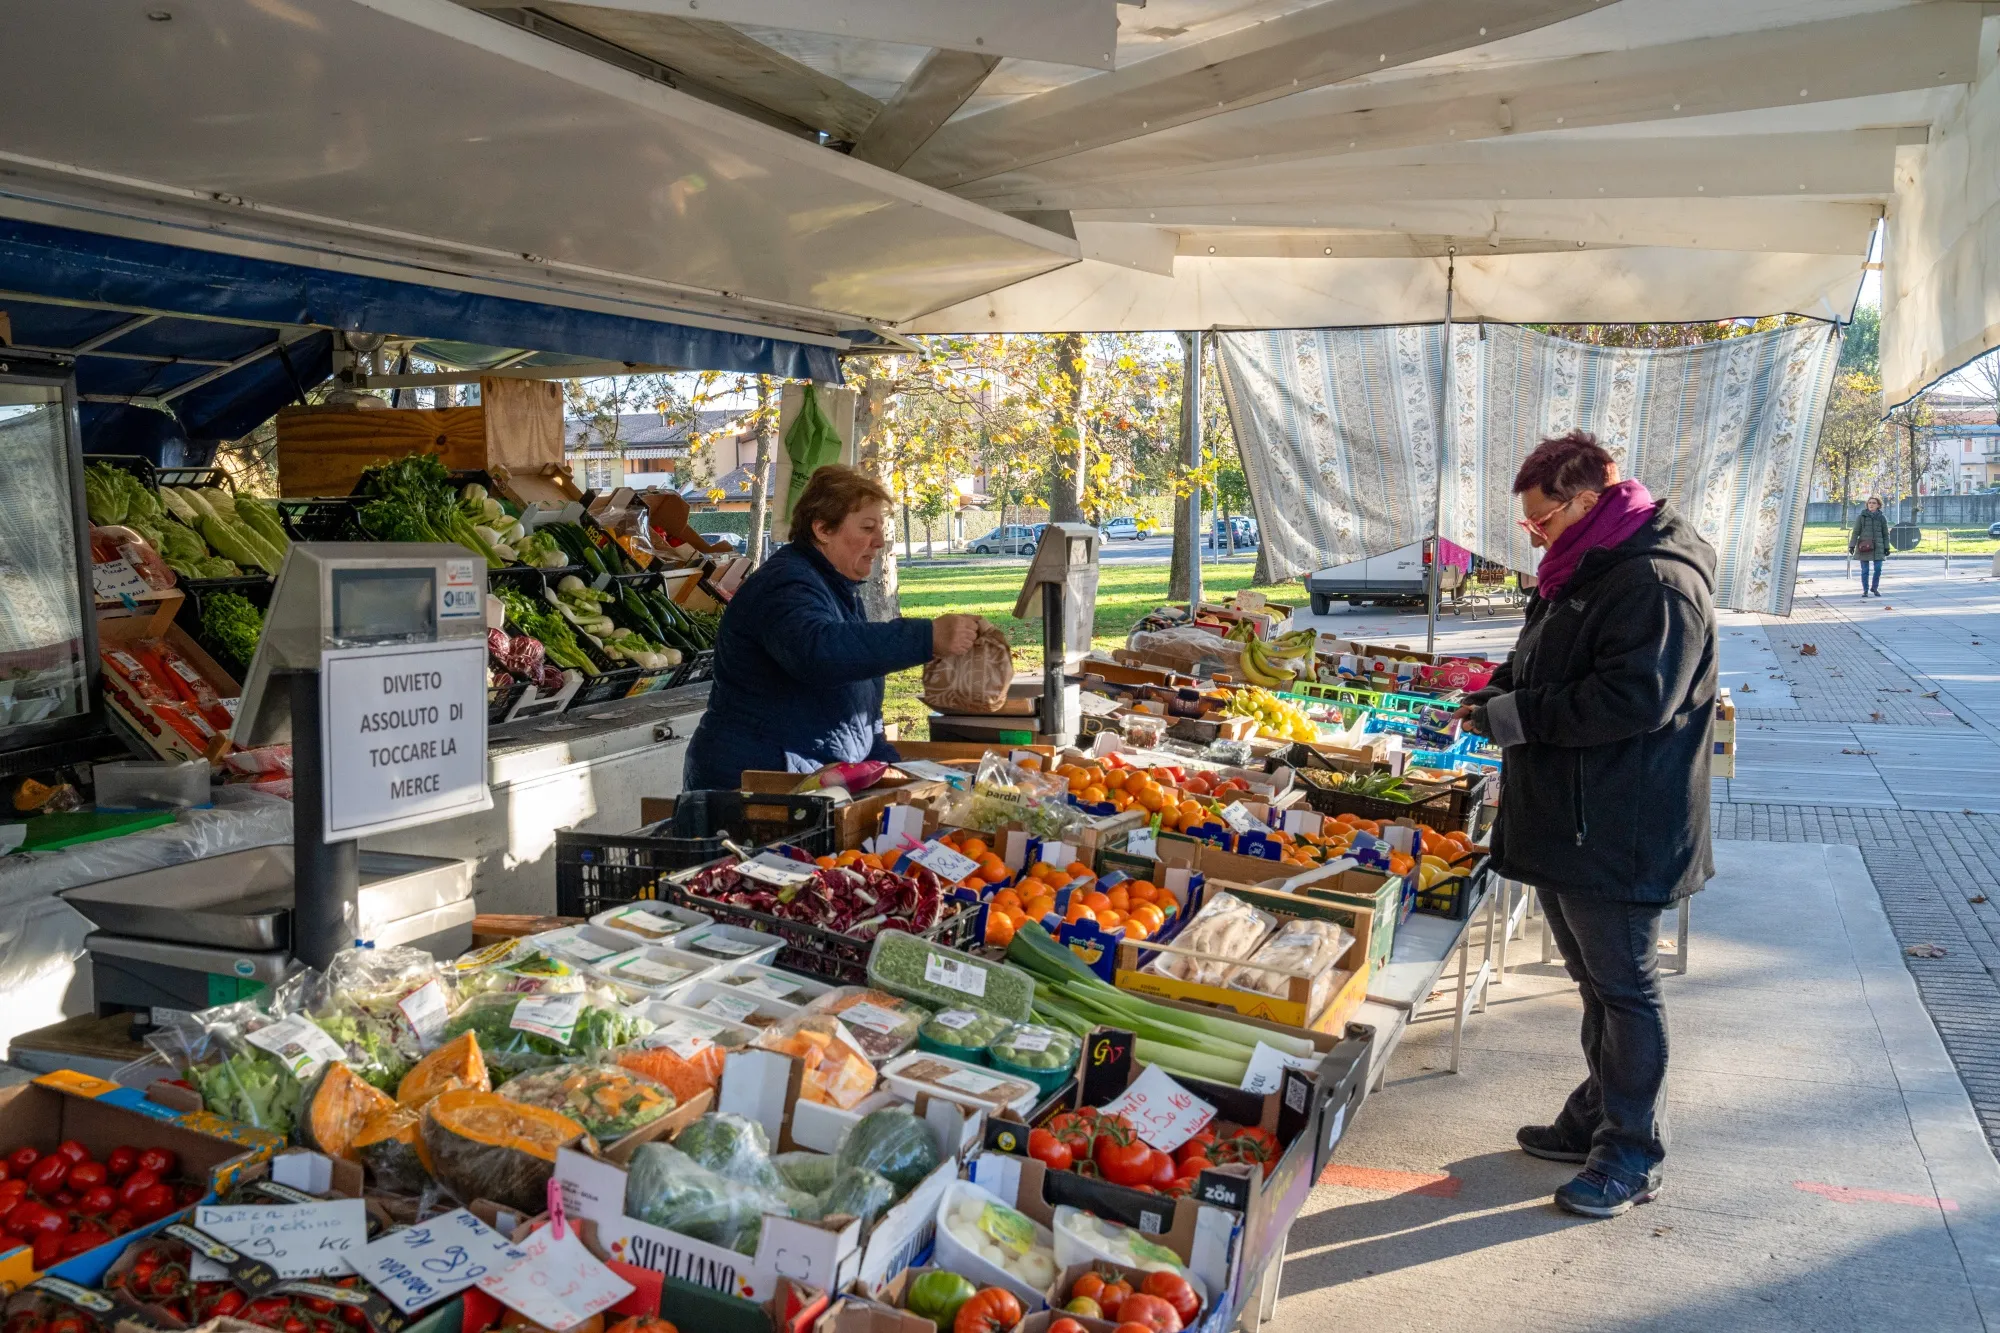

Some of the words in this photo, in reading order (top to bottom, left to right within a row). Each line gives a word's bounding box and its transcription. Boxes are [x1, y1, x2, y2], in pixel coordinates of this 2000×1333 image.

[383, 671, 442, 695] DIVIETO
[360, 706, 439, 734] ASSOLUTO
[450, 703, 463, 721] DI
[370, 740, 437, 768] TOCCARE
[441, 738, 457, 755] LA
[391, 774, 440, 800] MERCE
[628, 1234, 737, 1295] SICILIANO
